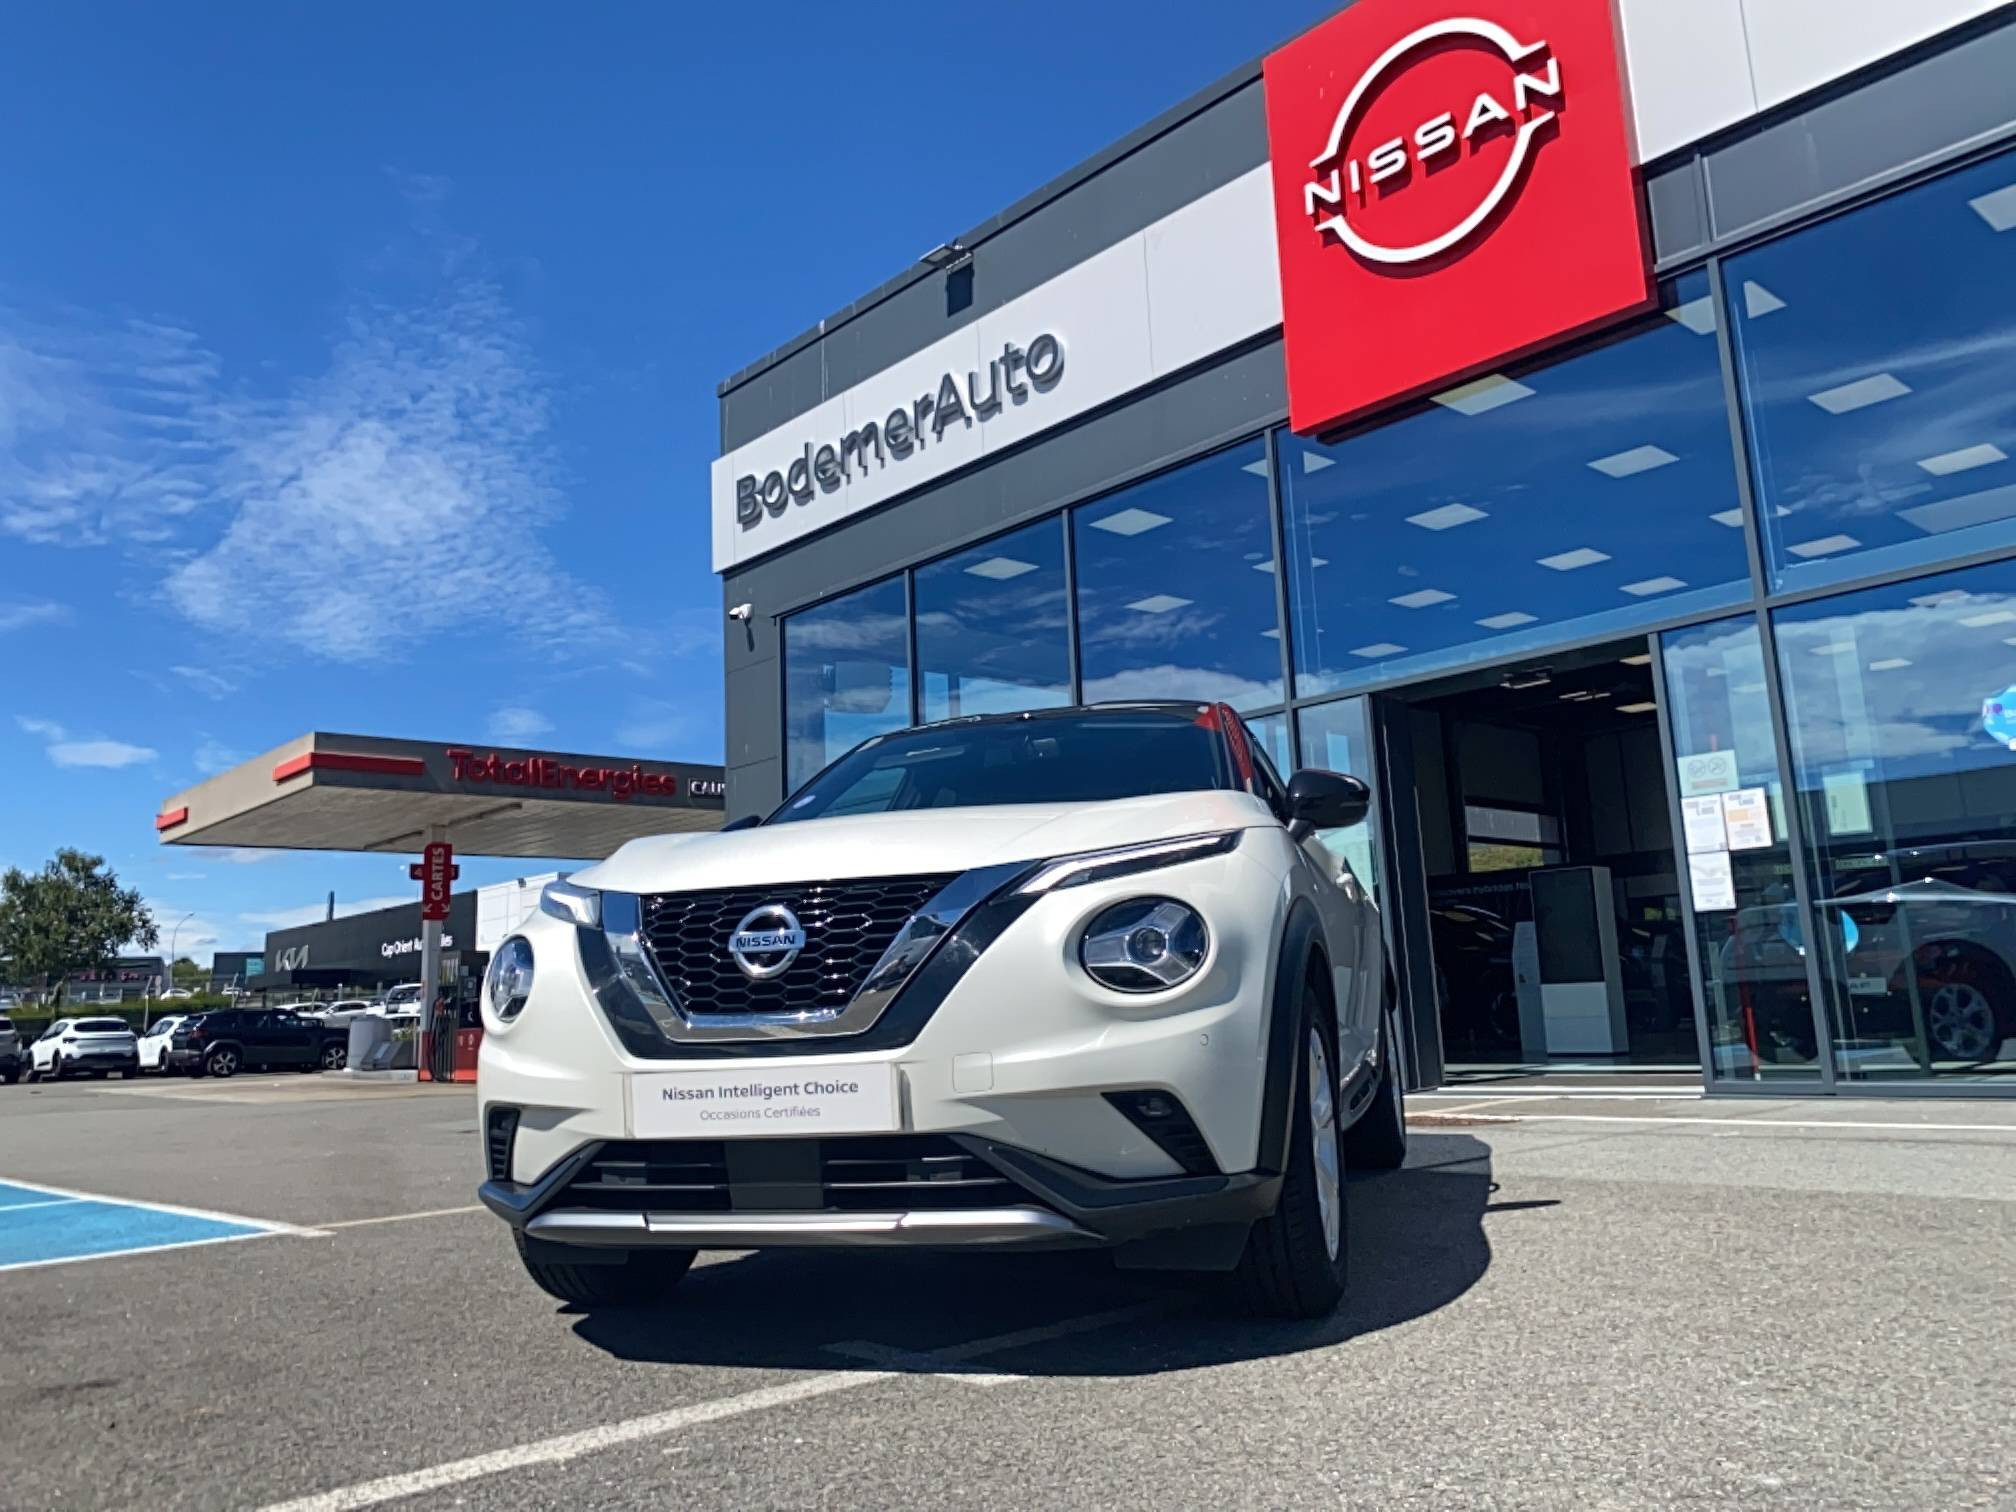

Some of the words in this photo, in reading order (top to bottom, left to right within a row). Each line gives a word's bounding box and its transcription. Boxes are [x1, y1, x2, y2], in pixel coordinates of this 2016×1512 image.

[1304, 57, 1561, 216] NISSAN
[736, 333, 1065, 532] BodemerAuto
[446, 748, 677, 801] TotalEnergies
[431, 847, 445, 900] CARTES
[736, 935, 796, 948] NISSAN
[662, 1086, 714, 1100] Nissan
[718, 1083, 800, 1100] Intelligent
[804, 1080, 859, 1095] Choice
[700, 1108, 761, 1121] Occasions
[764, 1105, 821, 1118] Certifiées
